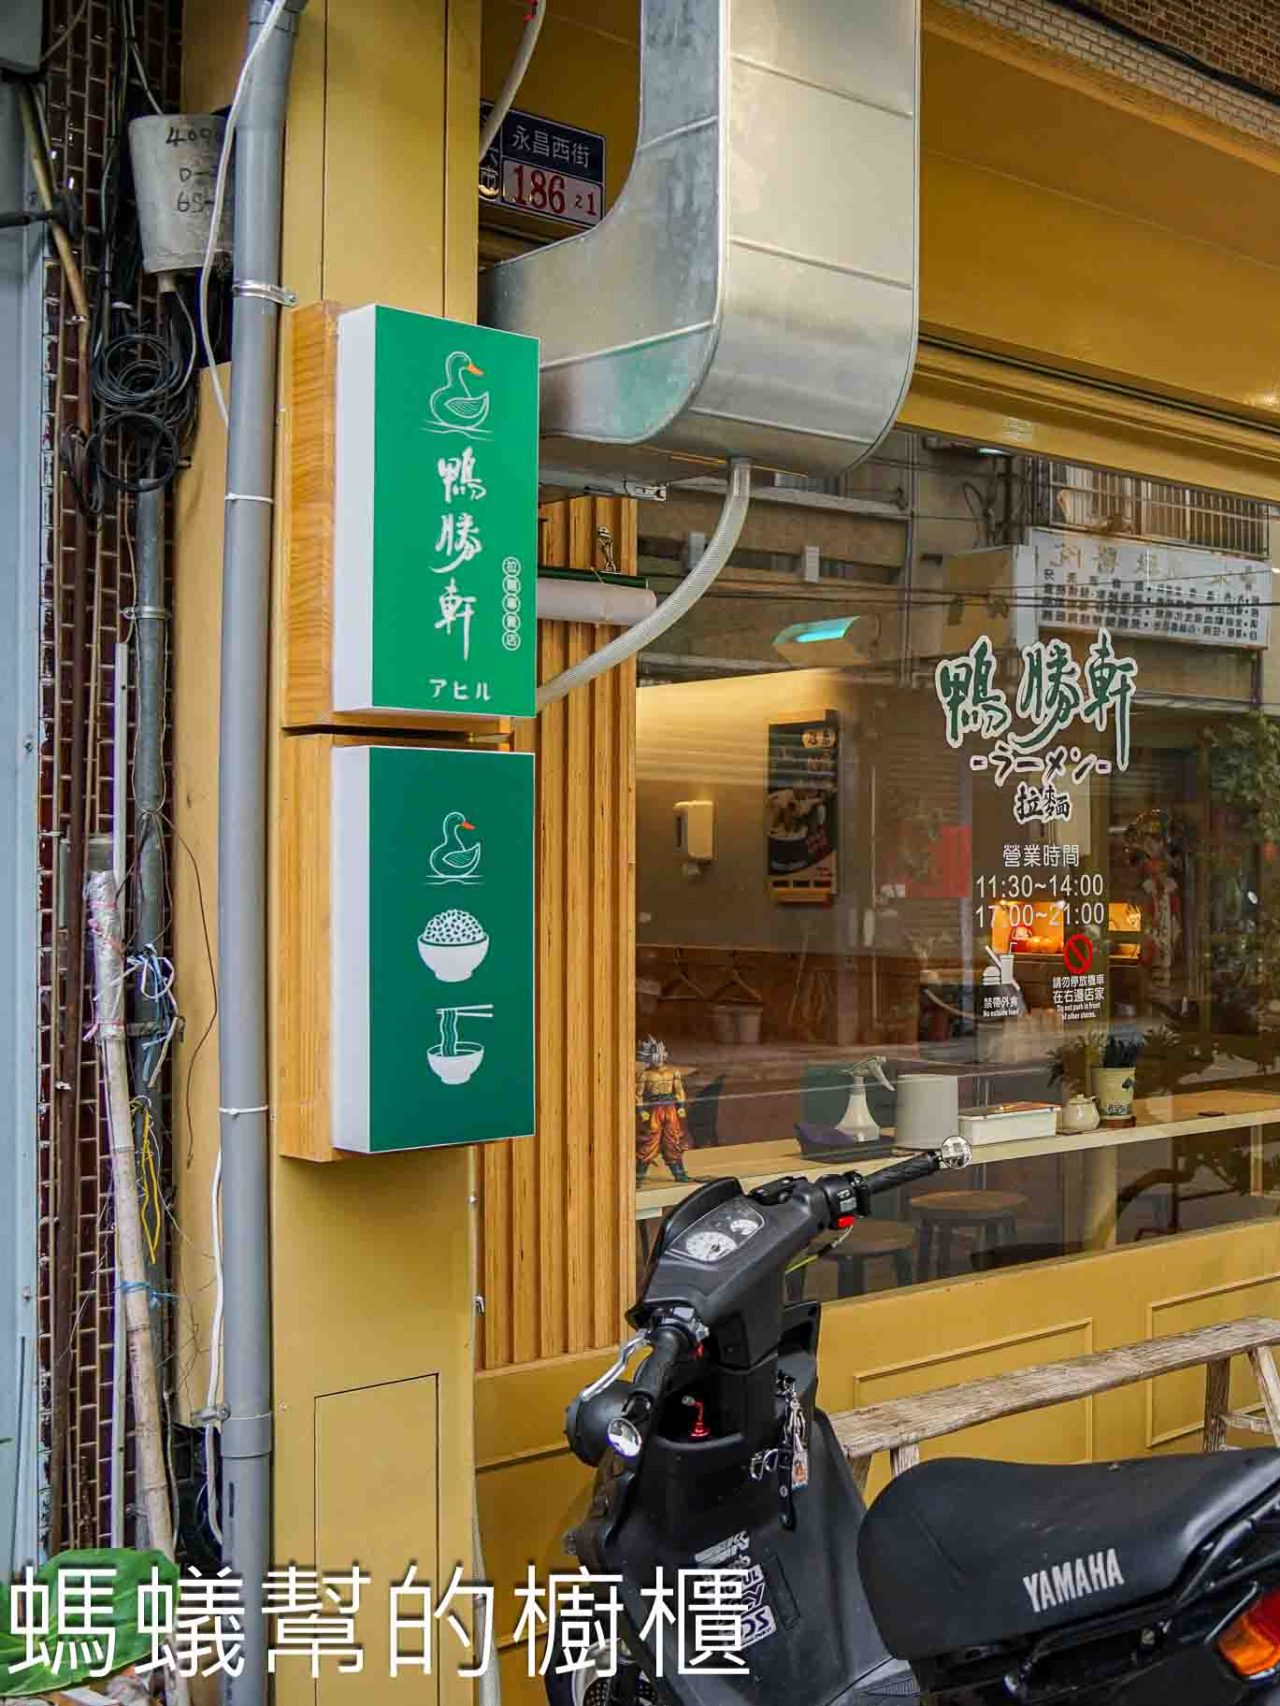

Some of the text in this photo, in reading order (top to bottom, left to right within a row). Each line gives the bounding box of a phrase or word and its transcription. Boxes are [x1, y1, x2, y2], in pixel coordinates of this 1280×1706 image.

[512, 125, 590, 168] 永昌西街
[429, 447, 487, 661] 鴨勝軒
[429, 678, 491, 702] アヒル
[936, 628, 1138, 771] 鴨勝軒
[1014, 783, 1071, 823] 拉麵
[1003, 845, 1080, 868] 營業時間
[976, 875, 1104, 898] 11:30~14:00
[1022, 1548, 1125, 1613] YAMAHA
